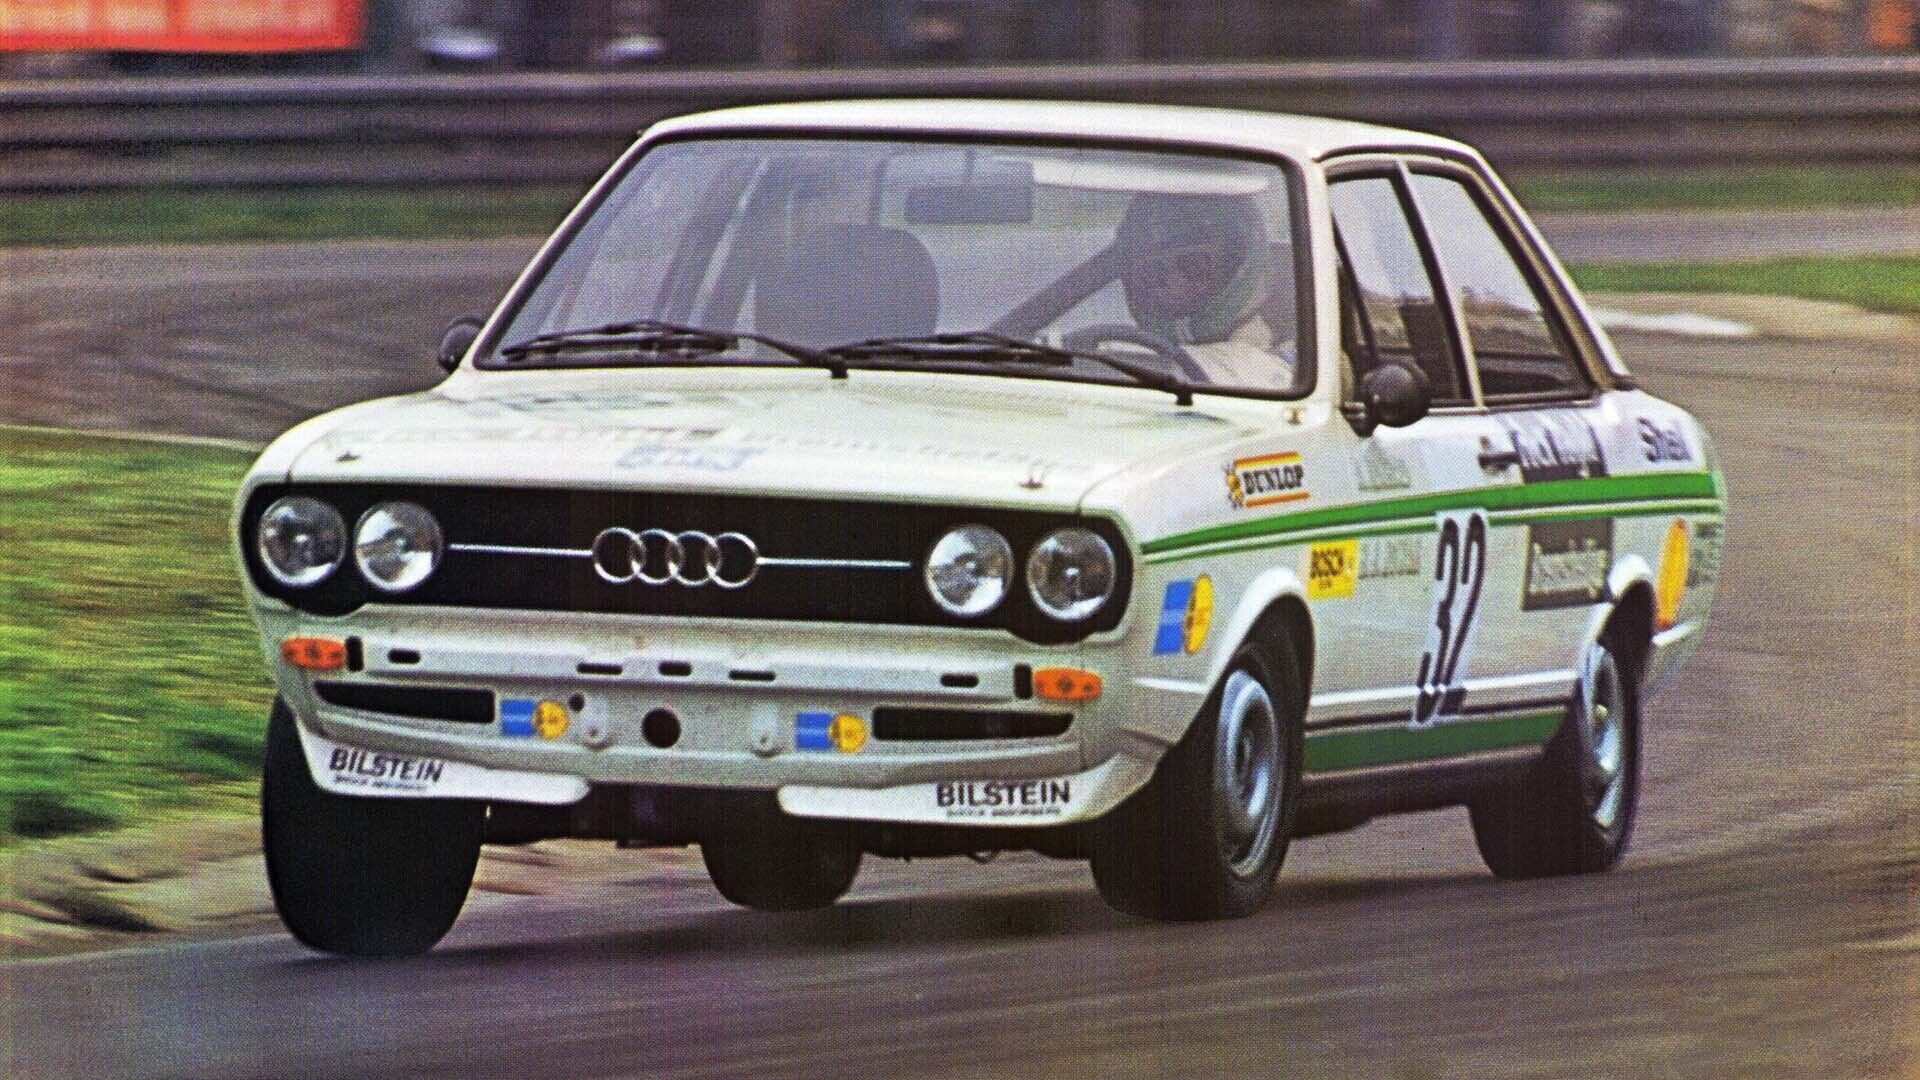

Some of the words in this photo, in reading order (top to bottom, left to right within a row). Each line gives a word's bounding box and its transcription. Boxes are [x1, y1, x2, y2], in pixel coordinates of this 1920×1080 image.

[1242, 464, 1304, 495] DUNLOP
[1416, 513, 1487, 722] 32
[329, 747, 445, 783] BILSTEIN
[936, 778, 1071, 807] BILSTEIN
